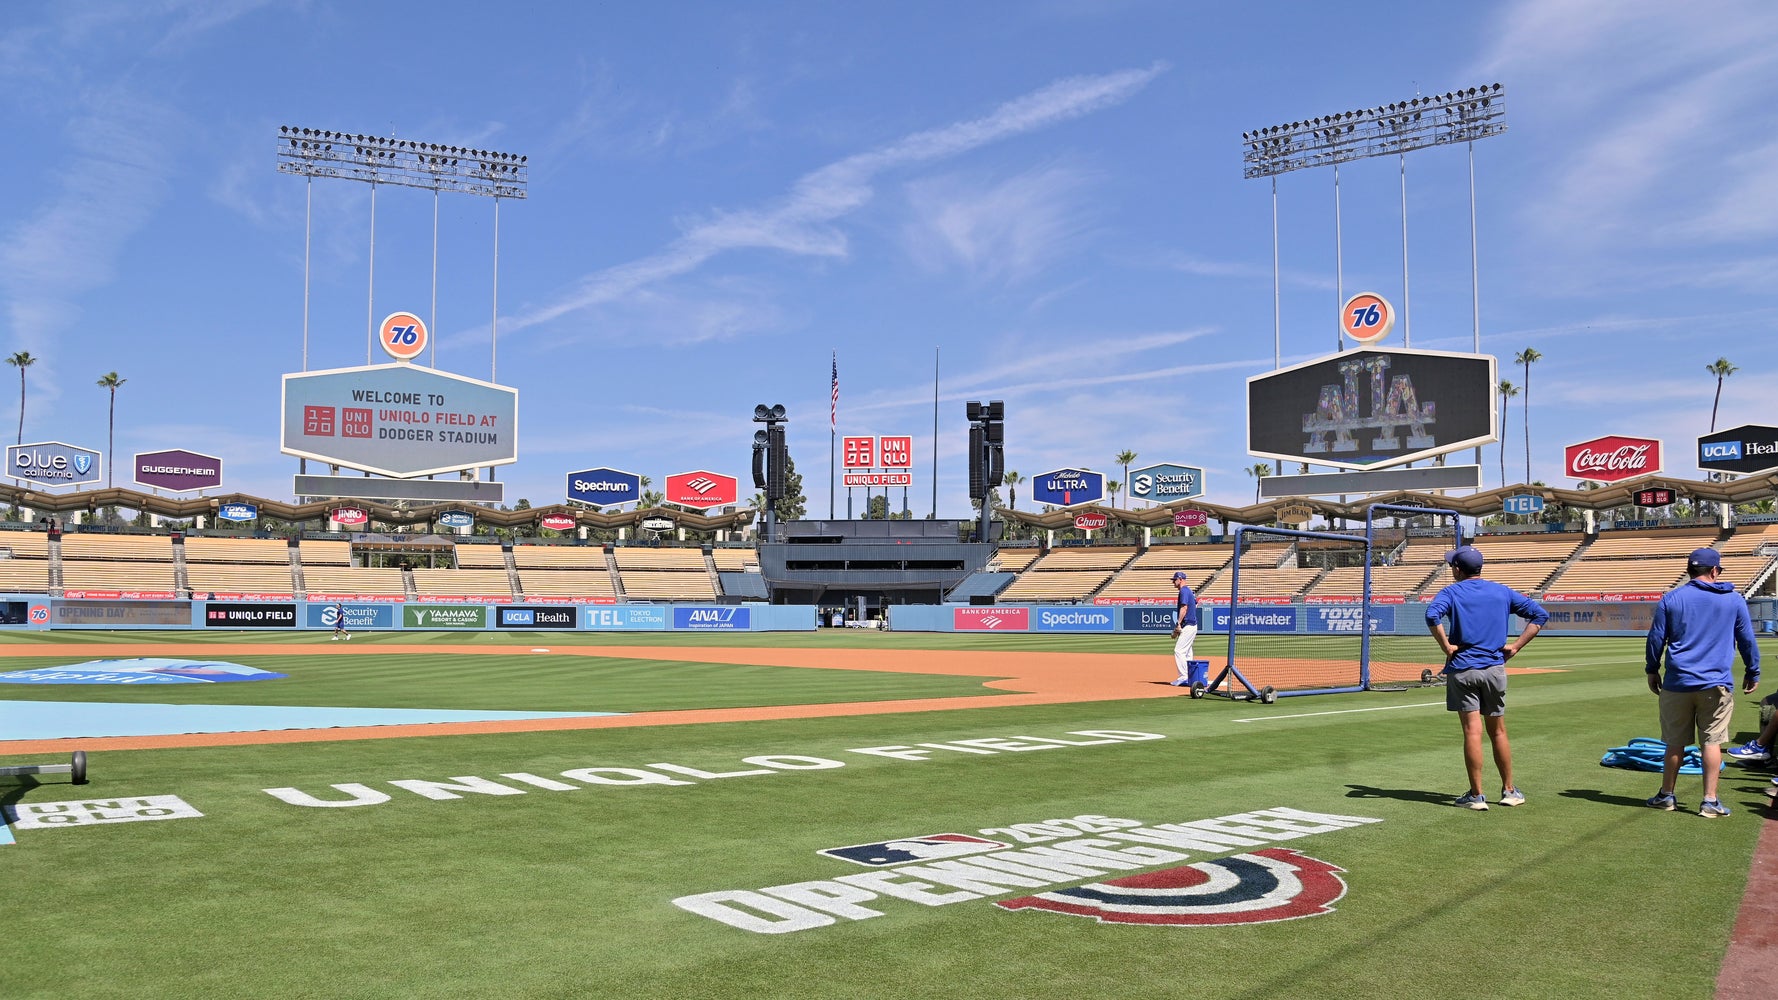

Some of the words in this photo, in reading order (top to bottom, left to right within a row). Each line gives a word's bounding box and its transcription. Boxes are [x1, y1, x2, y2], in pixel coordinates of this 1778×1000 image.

[1353, 304, 1380, 328] 76
[390, 325, 417, 344] 76
[352, 390, 421, 405] WELCOME
[428, 394, 444, 406] TO
[346, 412, 368, 422] UNI
[379, 410, 430, 424] UNIQLO
[436, 412, 476, 426] FIELD
[480, 415, 497, 427] AT
[345, 424, 369, 435] QLO
[379, 428, 434, 442] DODGER
[439, 430, 497, 444] STADIUM
[884, 440, 905, 451] UNI
[1705, 445, 1738, 457] UCLA
[16, 449, 67, 469] blue
[884, 453, 907, 465] QLO
[24, 468, 73, 478] california
[142, 466, 215, 476] GUGGENHEIM
[847, 476, 878, 485] UNIQLO
[882, 476, 908, 484] FIELD
[1156, 473, 1195, 484] Security
[574, 480, 628, 493] Spectrum
[1048, 480, 1088, 490] ULTRA
[1157, 484, 1190, 494] Benefit
[1508, 498, 1538, 511] TEL
[338, 509, 362, 520] JINRO
[1280, 510, 1291, 520] JIM
[1076, 517, 1104, 527] Churu
[32, 609, 47, 620] 76
[60, 607, 104, 617] OPENING
[107, 608, 125, 617] DAY
[229, 611, 263, 620] UNIQLO
[342, 607, 378, 617] Security
[536, 613, 570, 622] Health
[689, 610, 718, 621] ANA
[1319, 608, 1363, 619] TOYO
[1574, 612, 1594, 622] DAY
[343, 617, 373, 625] Benefit
[588, 610, 623, 626] TEL
[1042, 612, 1105, 627] Spectrum
[1142, 612, 1171, 624] blue
[1327, 620, 1377, 631] TIRES
[261, 754, 846, 808] UNIQLO
[846, 730, 1166, 761] FIELD
[29, 800, 152, 814] UNI
[37, 808, 175, 824] QLO
[978, 814, 1143, 843] 2026
[671, 839, 1189, 934] OPENING
[1099, 807, 1384, 853] WEEK
